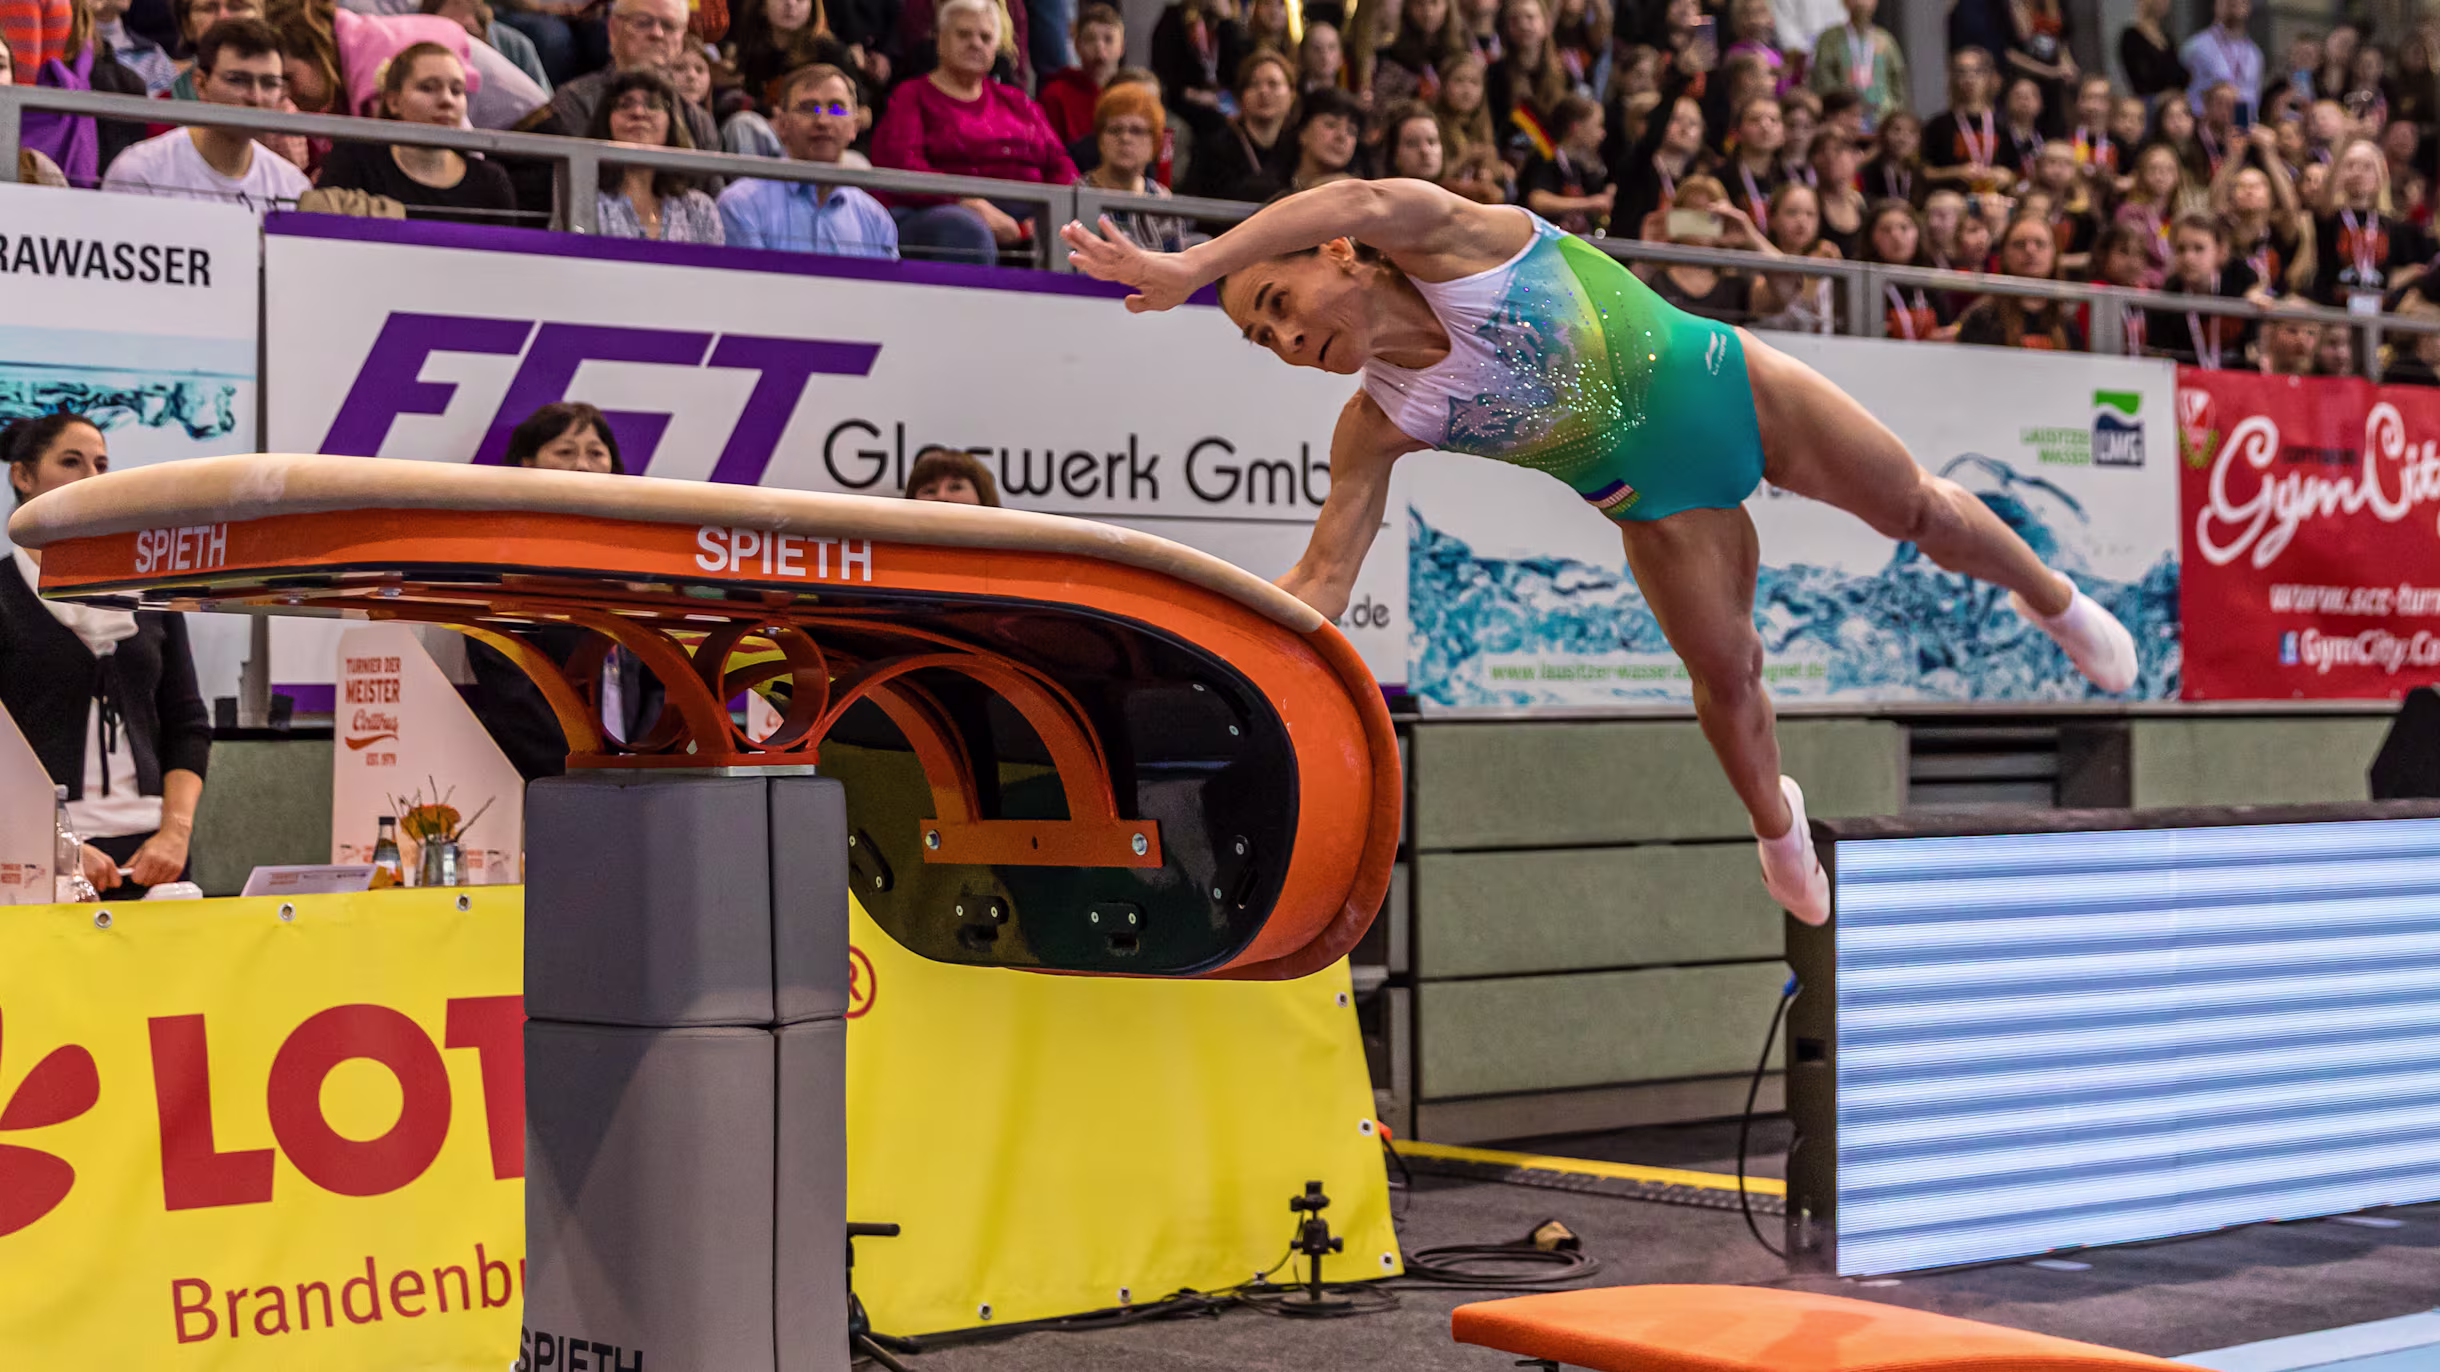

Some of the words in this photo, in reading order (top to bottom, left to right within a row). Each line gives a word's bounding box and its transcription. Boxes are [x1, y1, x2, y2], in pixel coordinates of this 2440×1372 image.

[823, 418, 1160, 501] Glwerk
[1185, 436, 1332, 506] Gmb
[135, 523, 228, 575] SPIETH
[695, 526, 873, 582] SPIETH
[345, 679, 400, 704] MEISTER
[147, 994, 526, 1211] LOT
[172, 1242, 526, 1344] Brandenb
